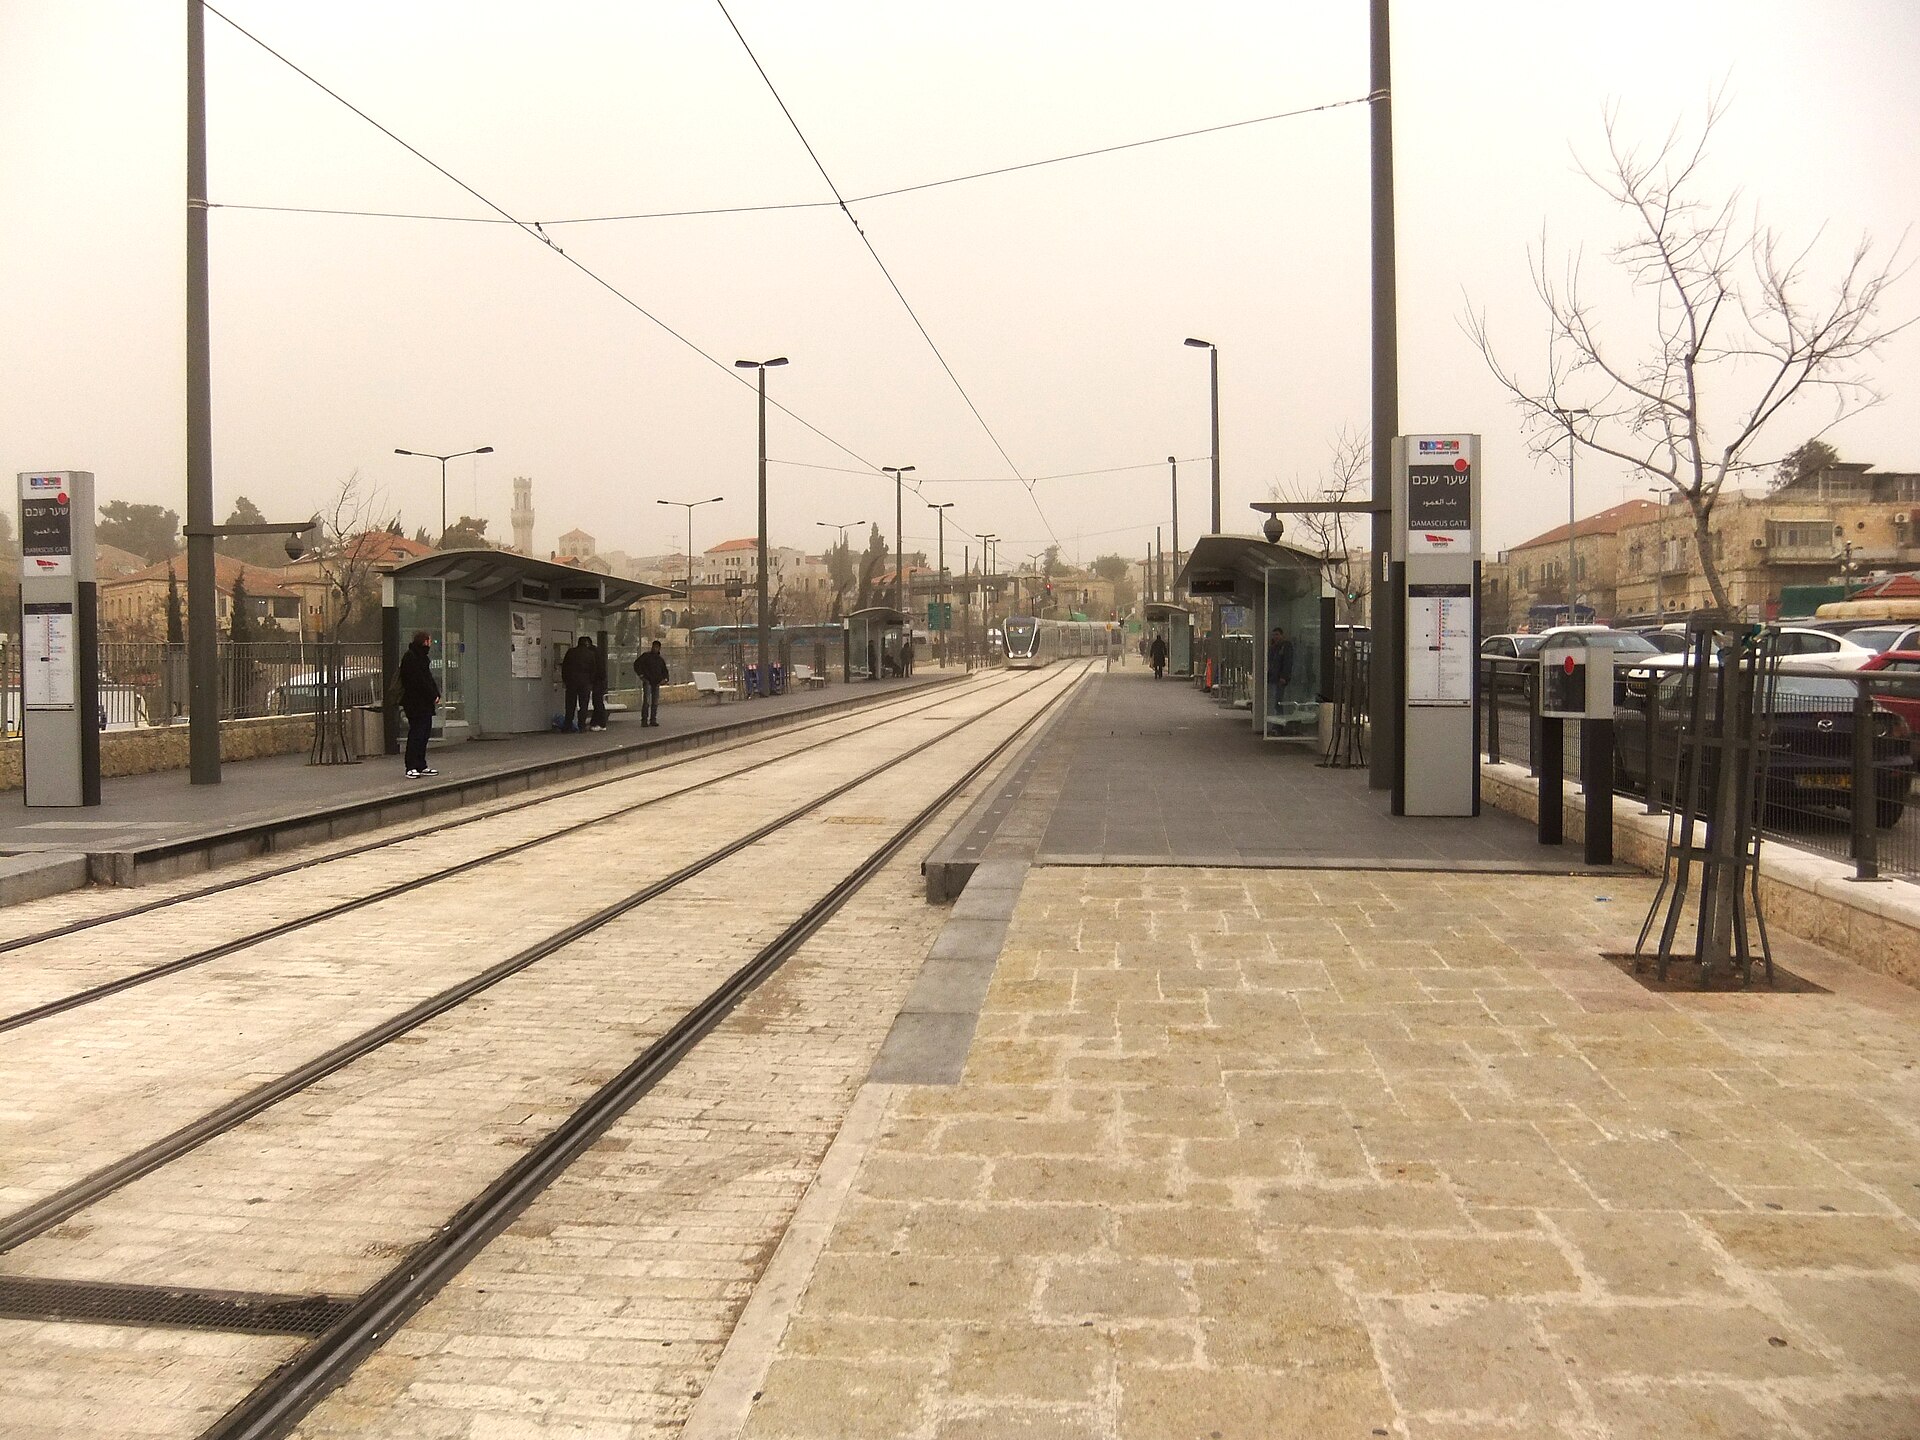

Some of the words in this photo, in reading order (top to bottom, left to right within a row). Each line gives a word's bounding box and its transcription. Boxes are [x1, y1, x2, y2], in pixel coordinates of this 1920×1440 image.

[1412, 475, 1439, 485] שכם
[1443, 475, 1468, 486] שער
[25, 508, 46, 517] שכם
[49, 507, 69, 517] שער
[1411, 519, 1448, 527] DAMASCUS
[1449, 519, 1467, 527] GATE
